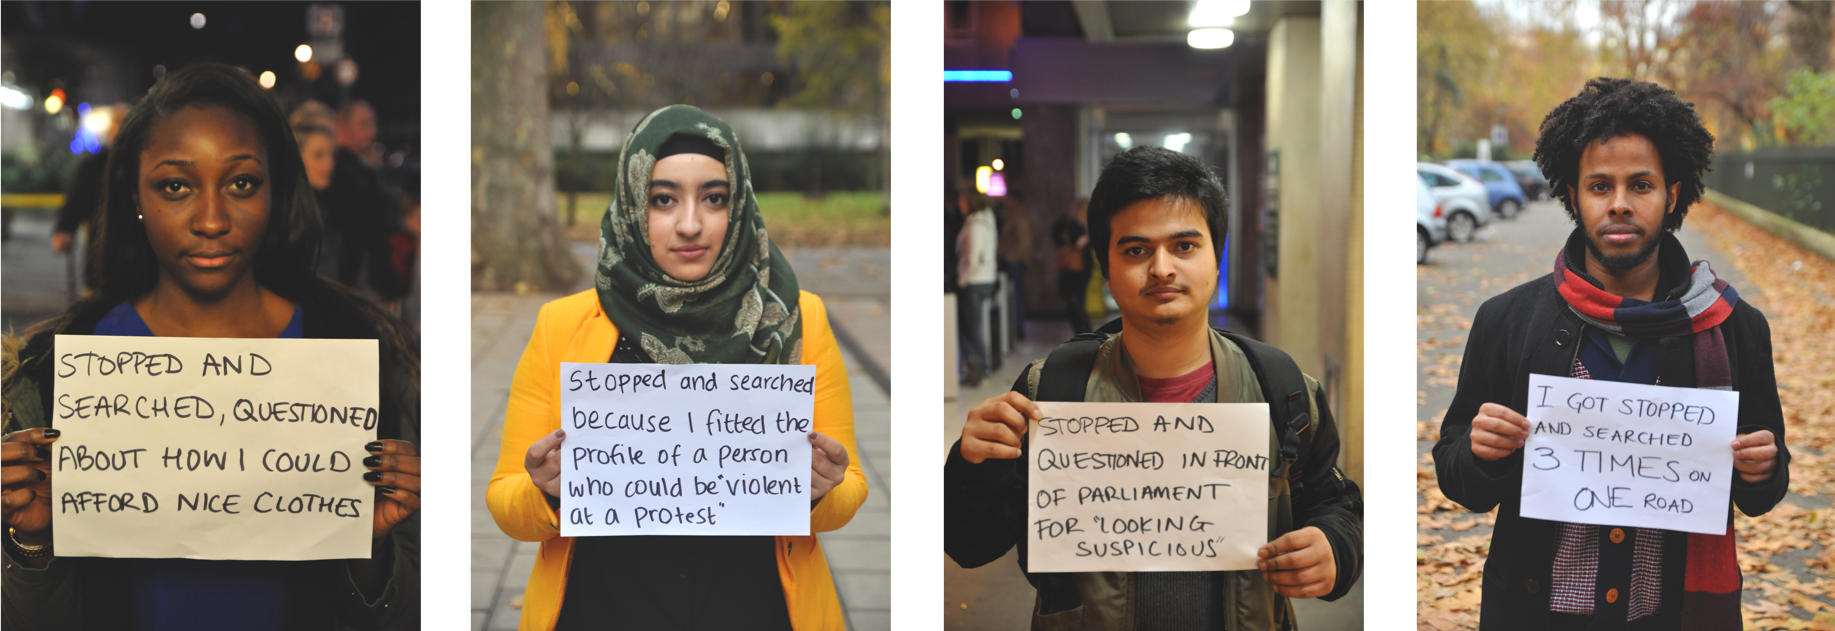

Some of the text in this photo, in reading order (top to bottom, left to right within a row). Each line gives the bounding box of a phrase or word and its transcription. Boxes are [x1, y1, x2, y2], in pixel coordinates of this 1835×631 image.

[57, 350, 273, 378] STOPPED AND
[569, 368, 815, 396] Stopped and searched
[57, 393, 378, 431] SEARCHED, QUESTIONED
[1536, 385, 1716, 426] I GOT STOPPED
[572, 406, 810, 436] because I fitted the
[1037, 415, 1215, 436] STOPPED AND
[1534, 420, 1693, 447] AND SEARCHED
[58, 444, 352, 473] ABOUT HOW I COULD
[572, 443, 789, 471] profile of a person
[1037, 448, 1269, 472] QUESTIONED IN FRONT
[1532, 446, 1712, 483] 3 TIMES ON
[568, 476, 614, 498] who
[624, 477, 683, 498] could
[1036, 483, 1231, 510] OF PARLIAMENT
[1573, 484, 1694, 514] ONE ROAD
[60, 490, 363, 518] AFFORD NICE CLOTHES
[569, 506, 594, 526] at
[604, 507, 621, 526] a
[1033, 517, 1086, 541] FOR
